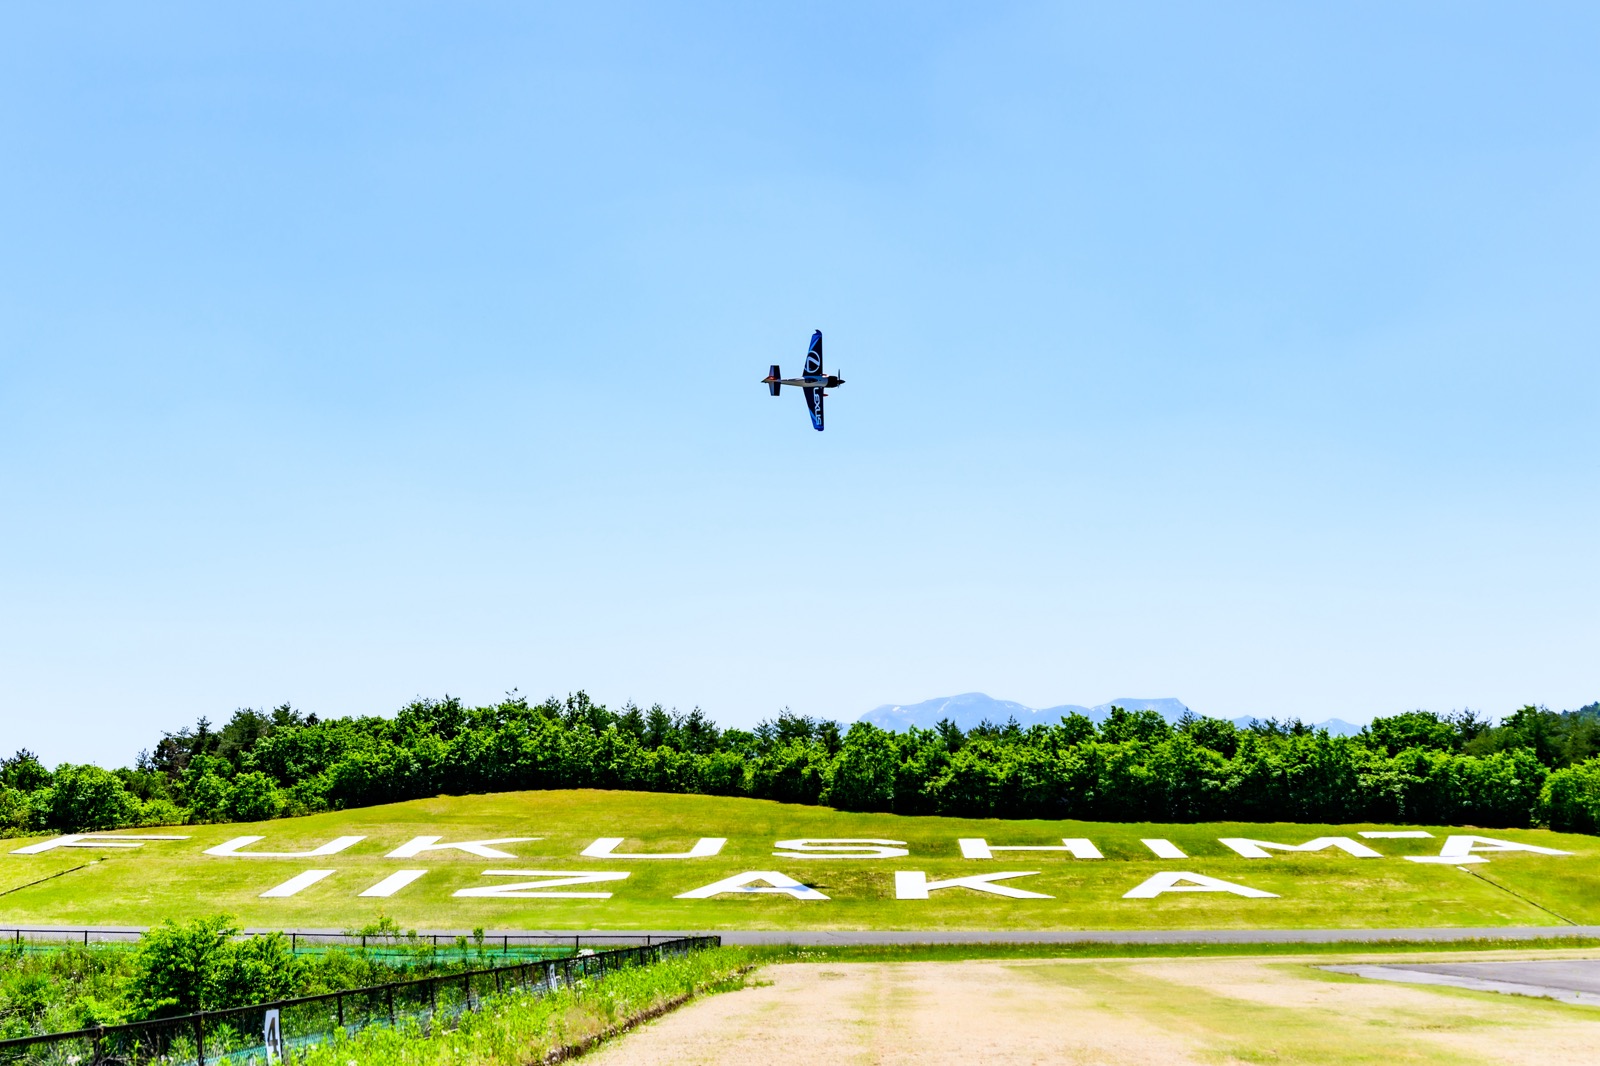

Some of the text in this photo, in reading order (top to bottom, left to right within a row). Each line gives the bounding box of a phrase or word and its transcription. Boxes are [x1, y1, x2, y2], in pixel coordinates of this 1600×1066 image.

[813, 387, 822, 425] LEXUS
[9, 832, 1573, 863] FUKUSHIMA
[260, 869, 1280, 901] IIZAKA
[267, 1017, 279, 1057] 4
